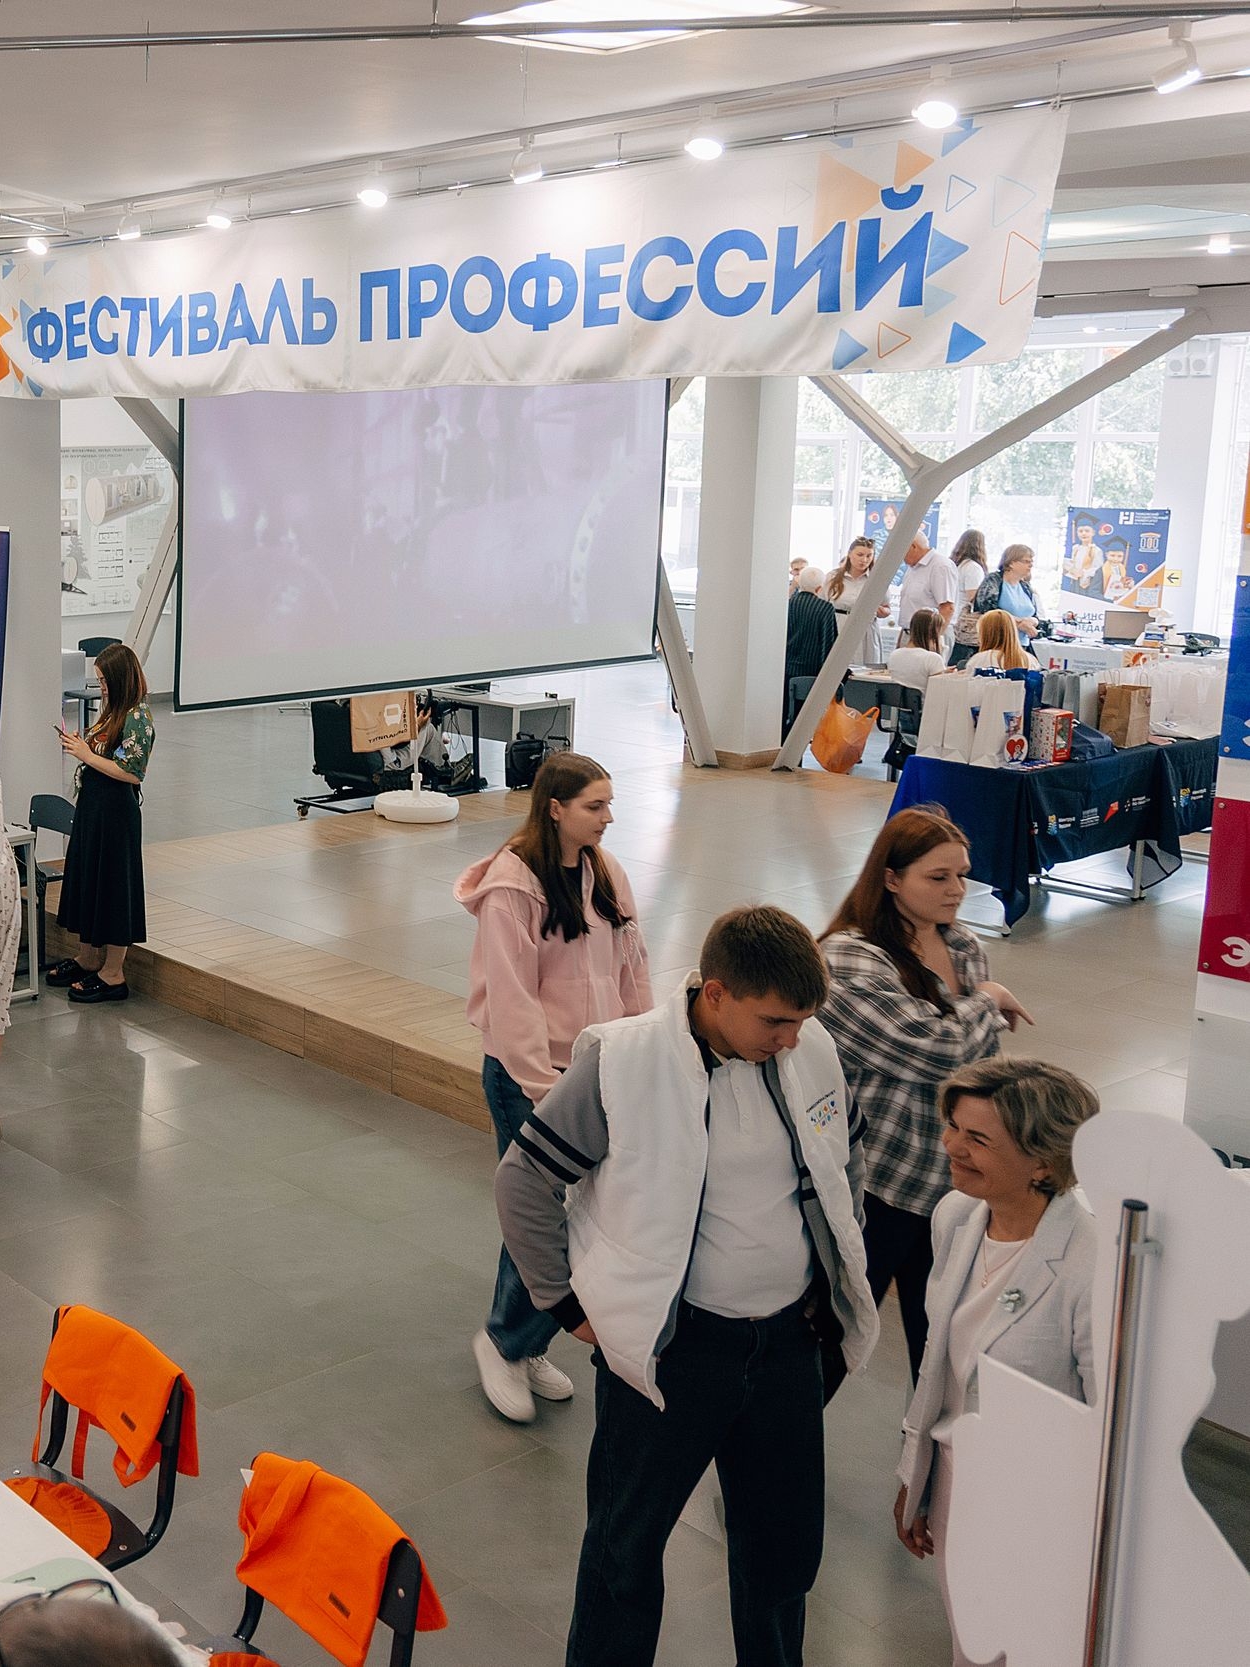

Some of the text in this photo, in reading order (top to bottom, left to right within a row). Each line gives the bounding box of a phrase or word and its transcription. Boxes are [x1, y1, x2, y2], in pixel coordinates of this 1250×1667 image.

[25, 184, 935, 363] ФЕСТИВАЛЬ ПРОФЕССИЙ
[1085, 612, 1104, 621] ИНС
[1075, 622, 1104, 632] ПЕДА
